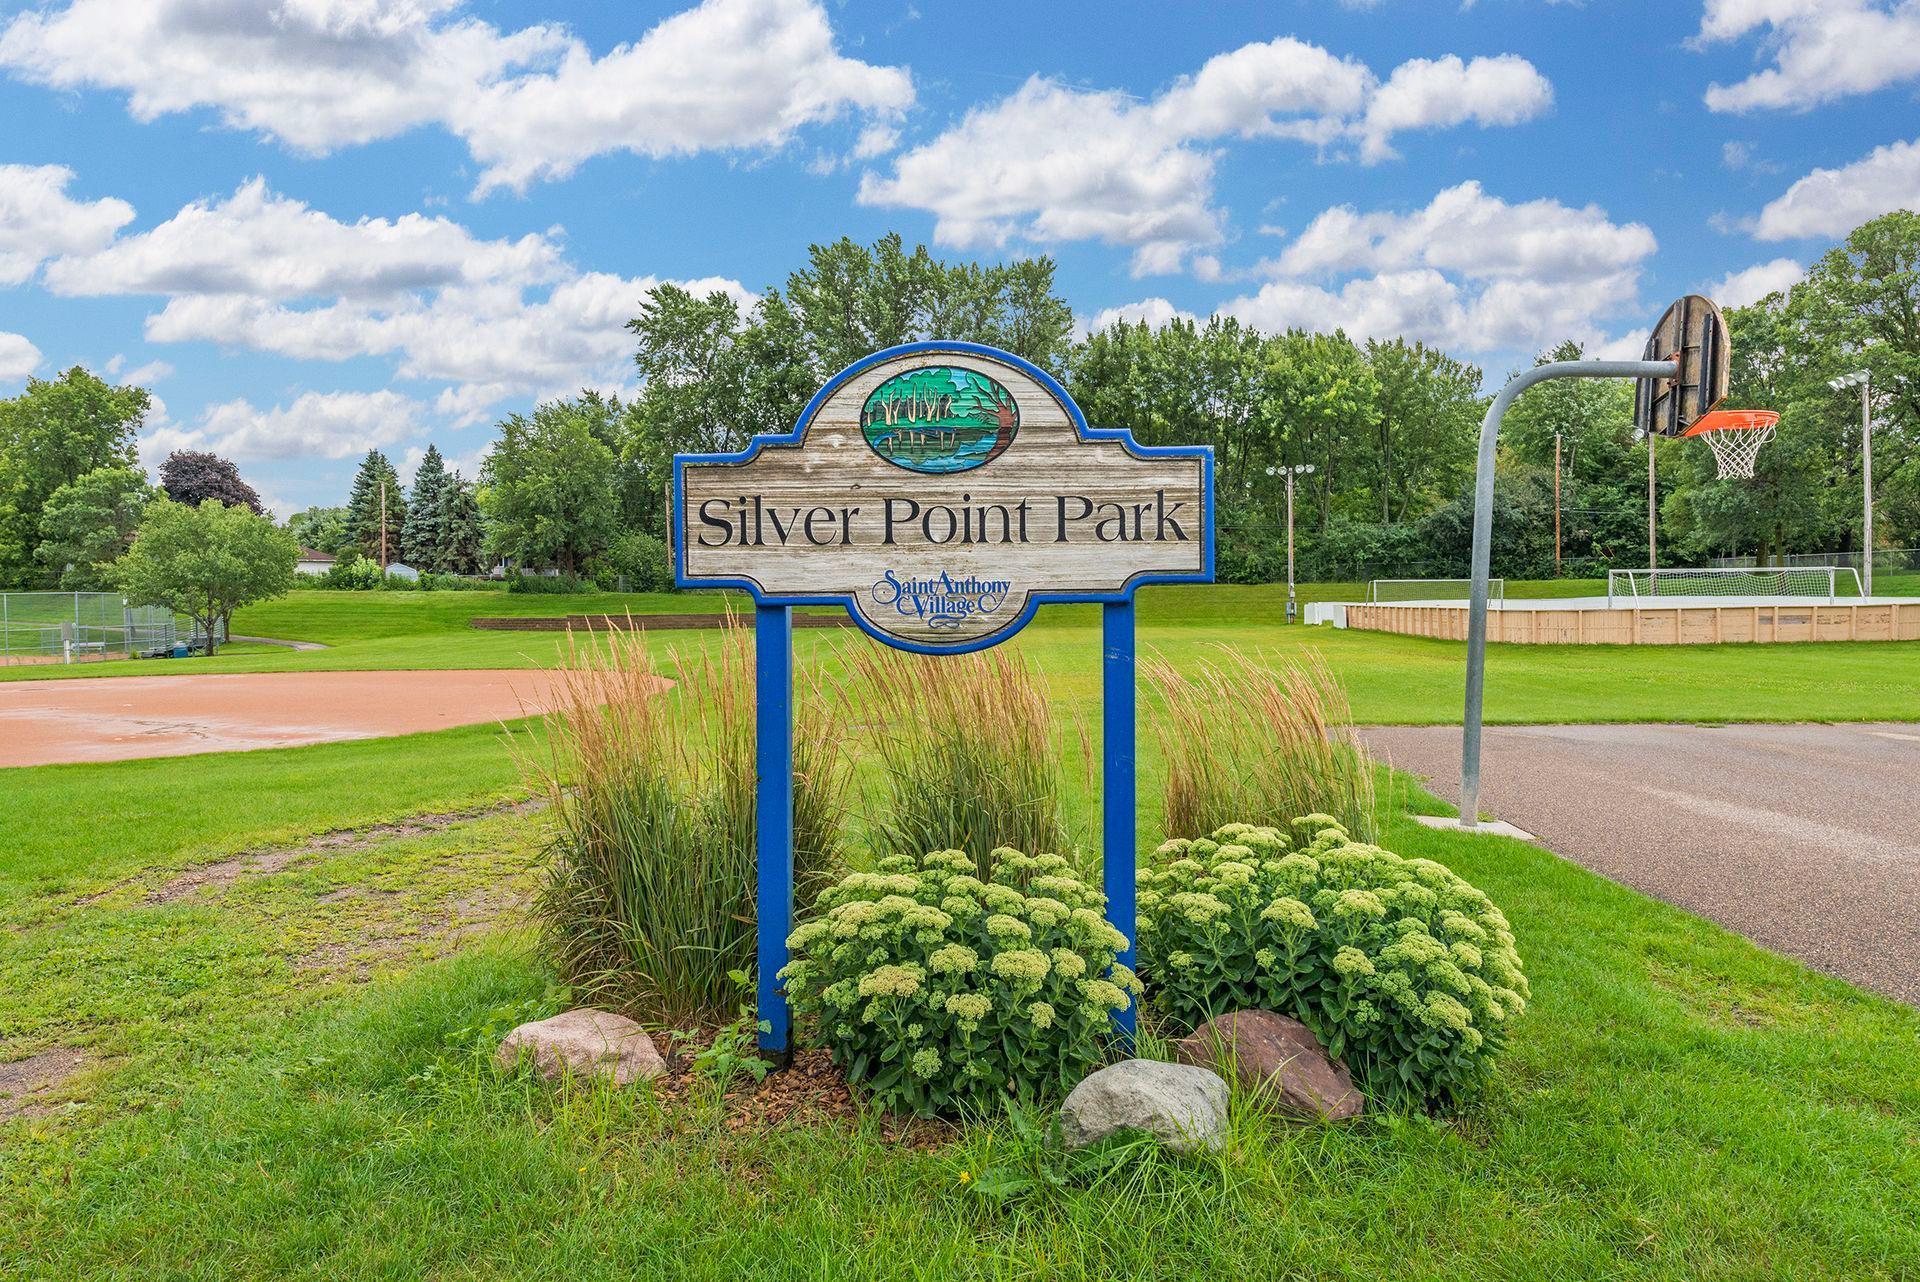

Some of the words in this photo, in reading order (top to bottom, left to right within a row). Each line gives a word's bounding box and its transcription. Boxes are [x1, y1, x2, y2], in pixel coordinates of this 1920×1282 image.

[698, 494, 860, 546] Silver
[883, 493, 1032, 545] Point
[1055, 490, 1189, 543] Park
[872, 569, 935, 604] Saint
[934, 569, 1011, 613] Anthony
[897, 594, 975, 628] Village
